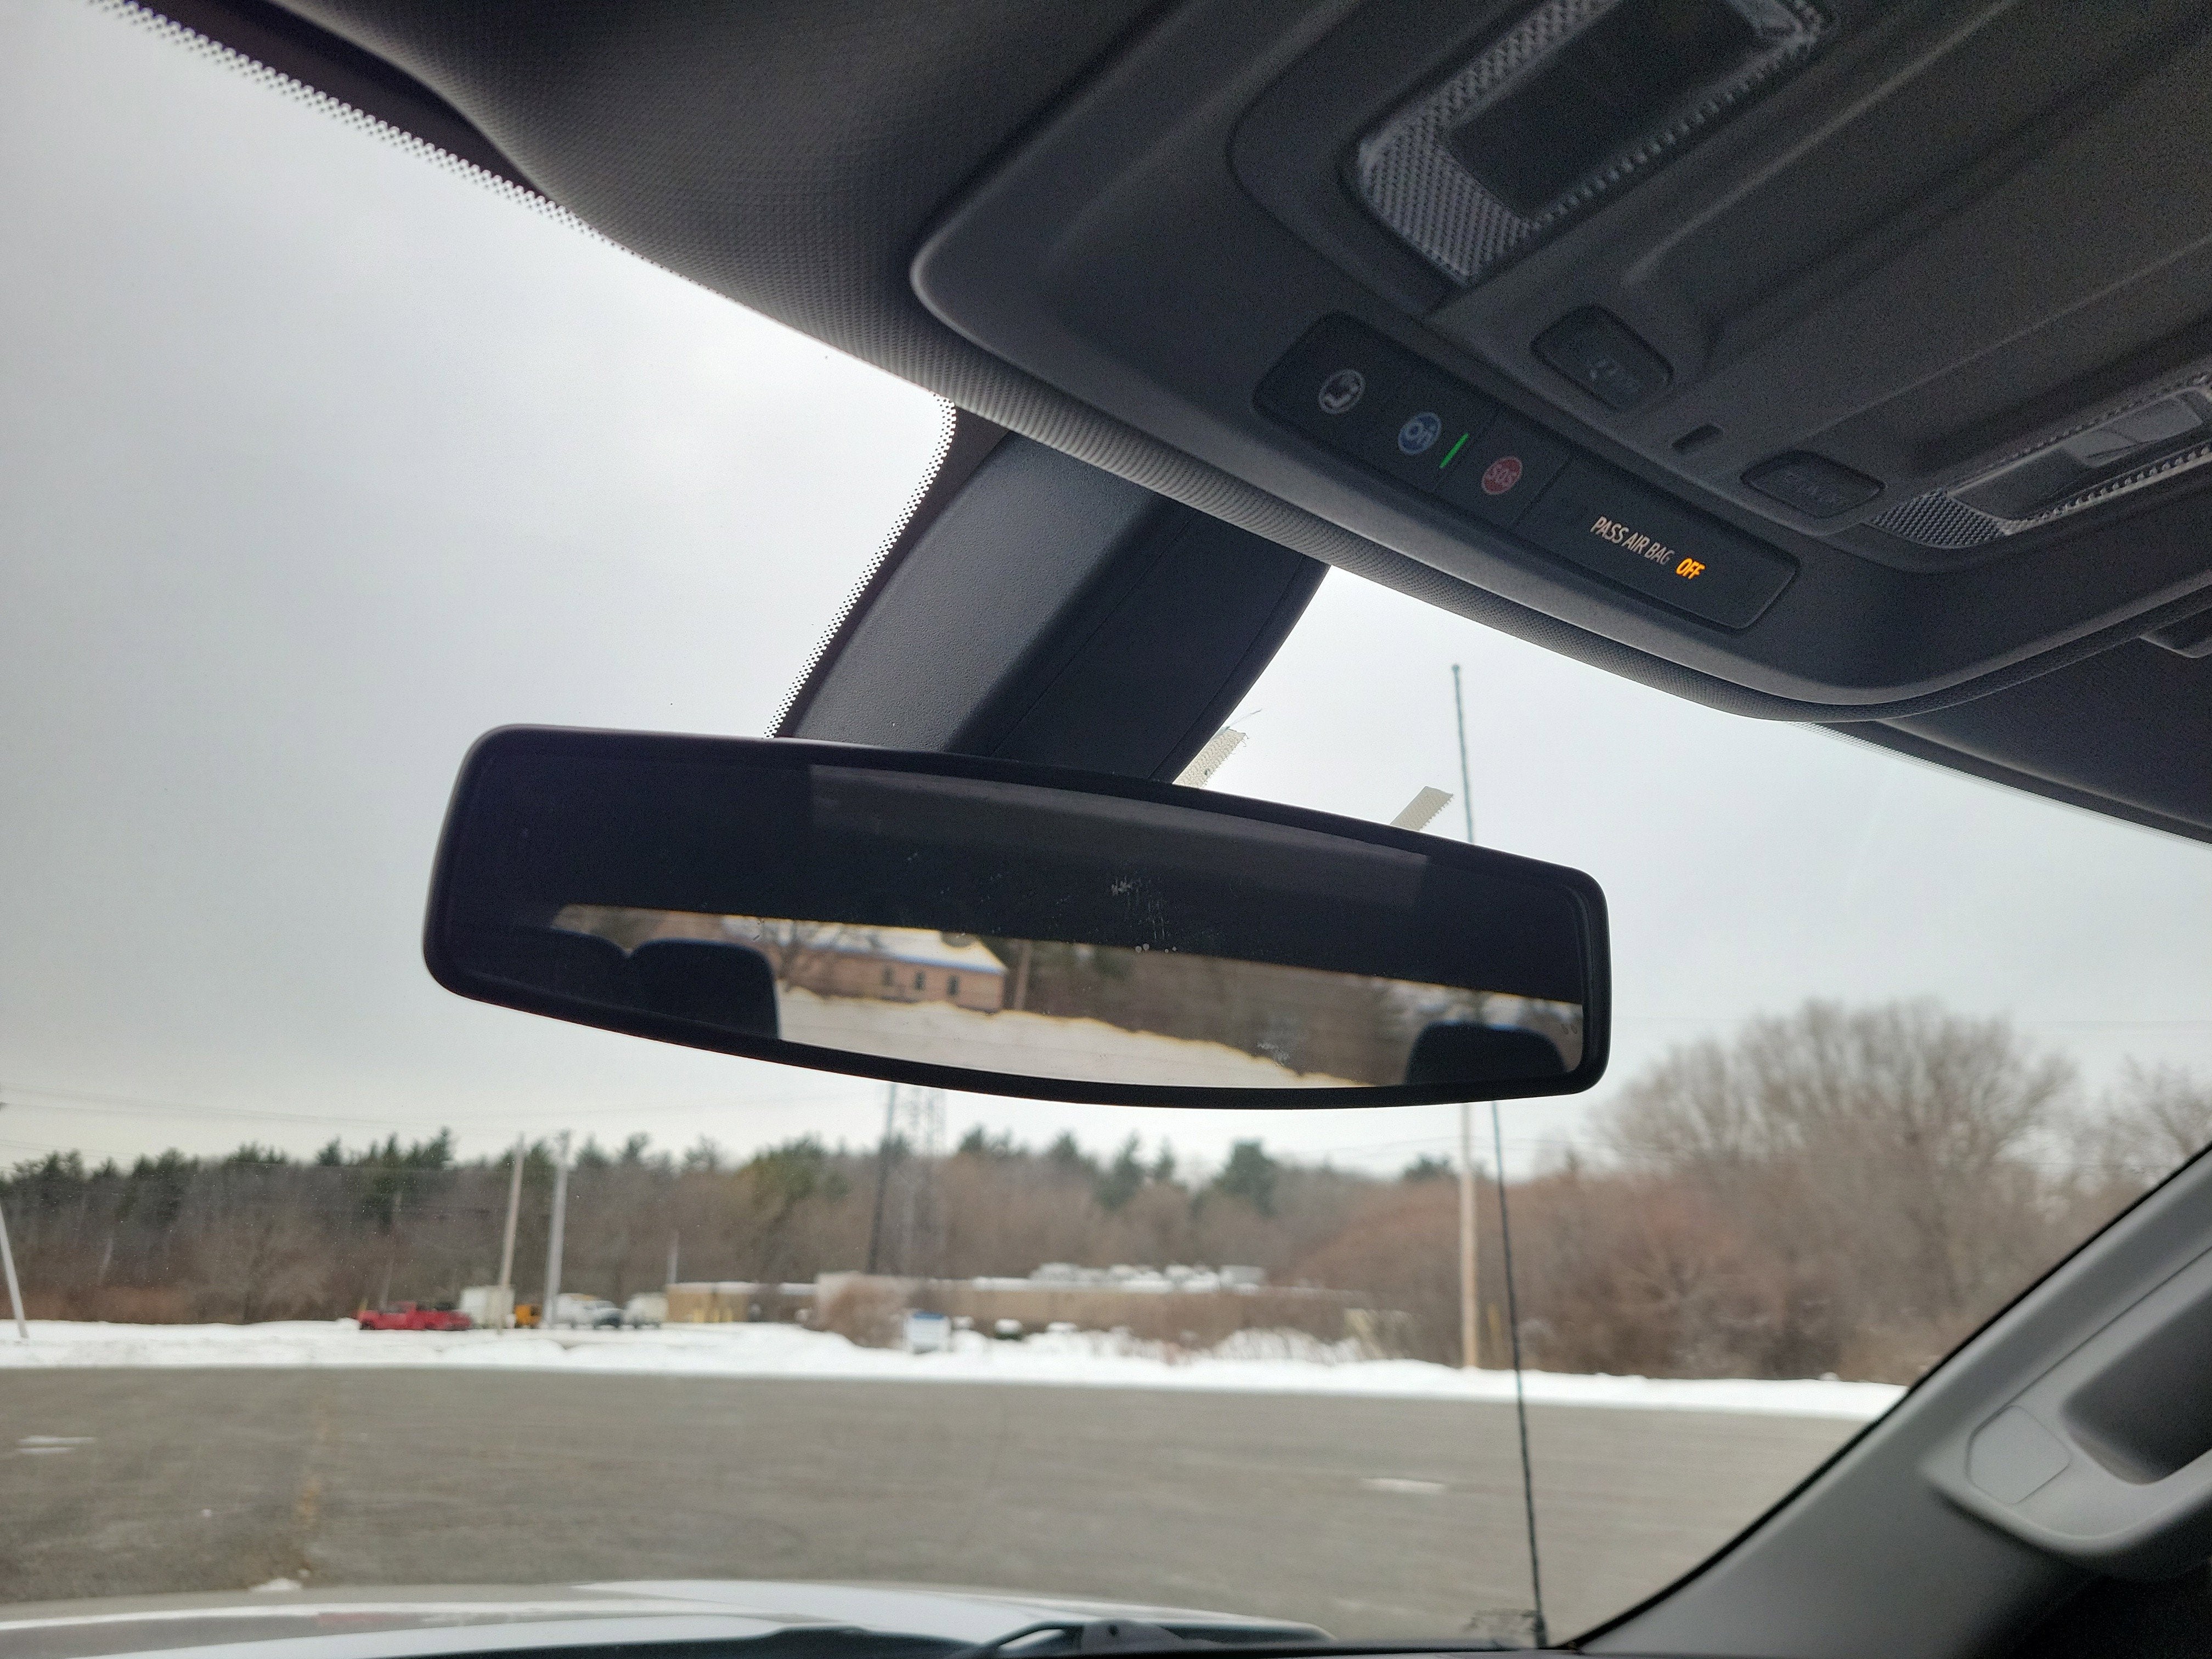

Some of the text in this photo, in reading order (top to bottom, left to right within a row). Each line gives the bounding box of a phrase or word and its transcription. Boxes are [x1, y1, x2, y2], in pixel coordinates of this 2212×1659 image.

[1486, 464, 1517, 487] SOS
[1590, 516, 1706, 580] PASS AIR BAG OFF
